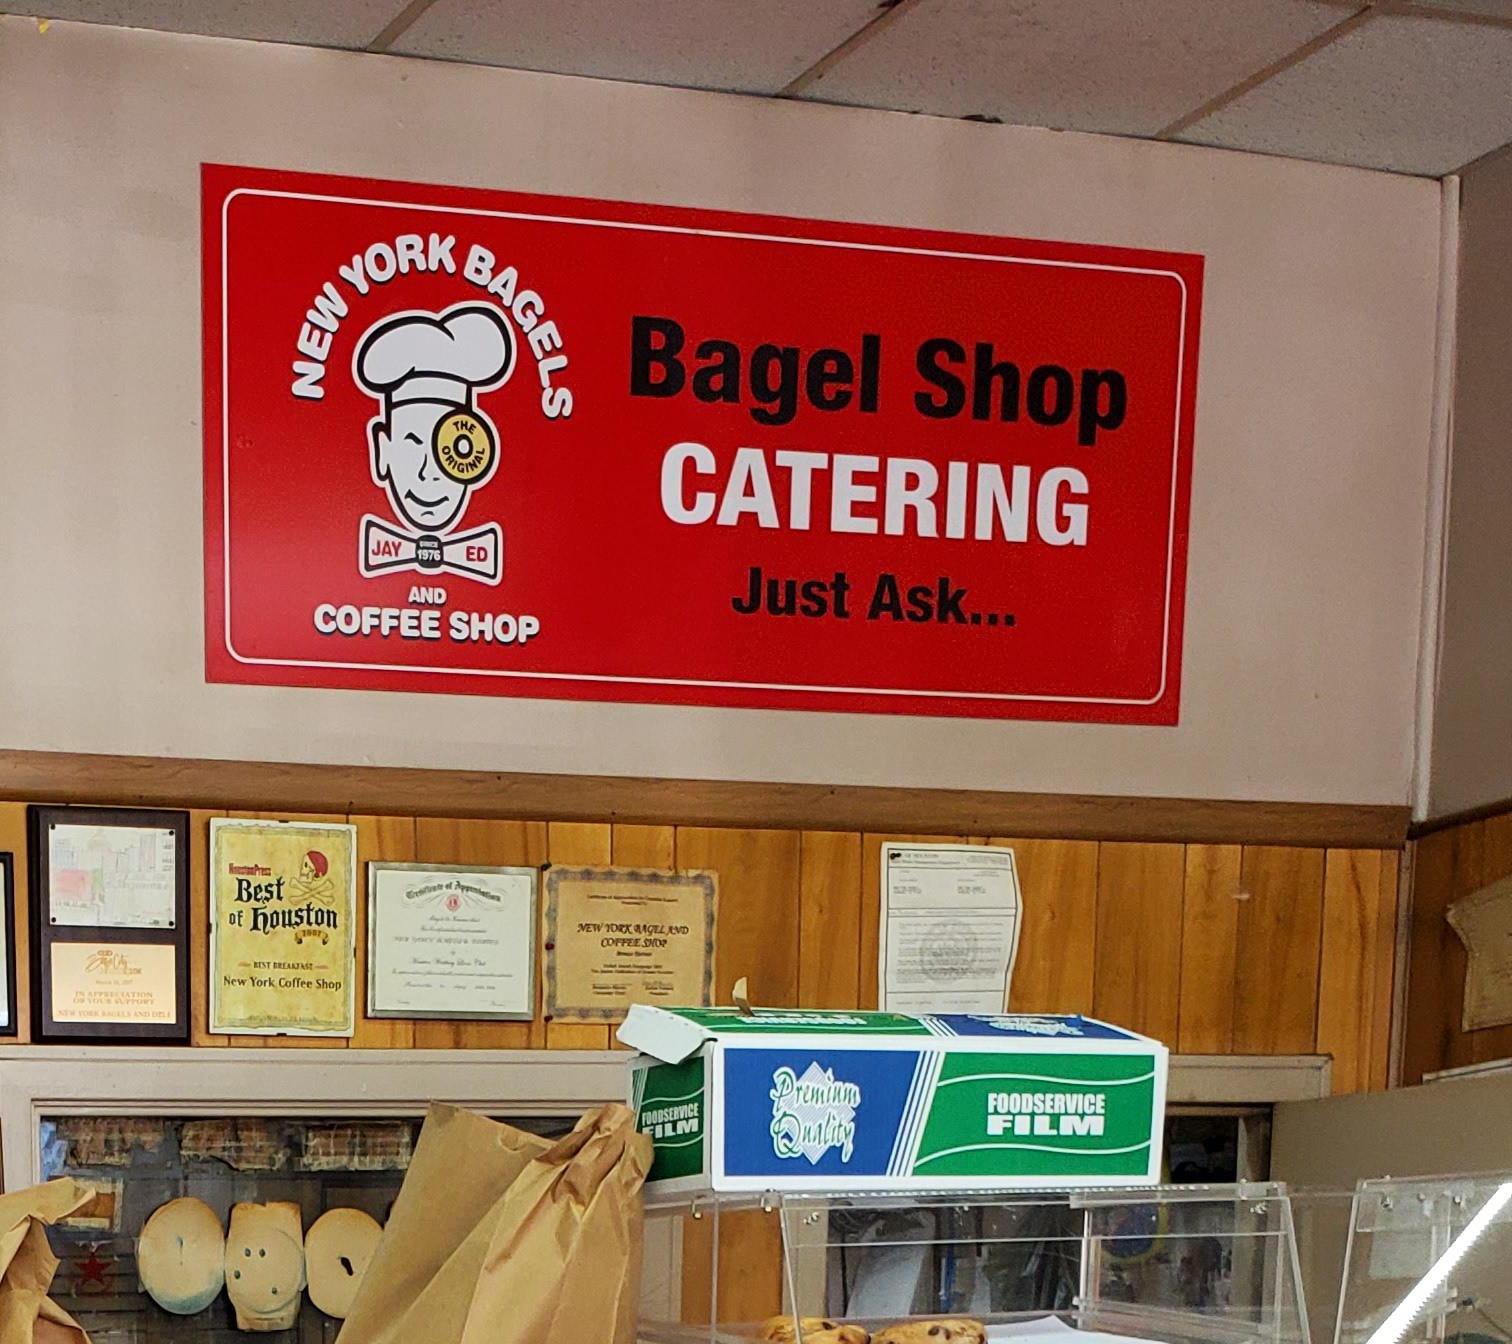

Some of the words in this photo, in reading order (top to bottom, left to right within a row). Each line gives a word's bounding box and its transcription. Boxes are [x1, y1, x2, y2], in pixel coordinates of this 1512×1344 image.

[292, 282, 349, 399] NEW
[339, 233, 456, 294] YORK
[463, 244, 573, 418] BAGELS
[629, 315, 880, 427] Bagel
[914, 338, 1127, 446] Shop
[453, 421, 477, 434] THE
[441, 446, 485, 474] ORIGINAL
[661, 441, 1089, 547] CATERING
[372, 540, 402, 557] JAY
[466, 546, 488, 562] ED
[417, 550, 441, 561] 1976
[408, 586, 447, 605] AND
[731, 566, 850, 619] Just
[867, 573, 1015, 627] Ask...
[314, 604, 441, 639] COFFEE
[449, 611, 540, 644] SHOP
[235, 876, 286, 903] Best
[229, 910, 244, 927] of
[250, 903, 338, 935] Houston
[577, 923, 603, 933] NEW
[606, 923, 632, 934] YORK
[634, 924, 666, 936] BAGEL
[666, 925, 689, 936] AND
[601, 939, 641, 947] COFFEE
[642, 939, 668, 948] SHOP
[253, 961, 271, 970] BEST
[273, 961, 313, 970] BREAKFAST
[224, 976, 247, 987] New
[249, 976, 275, 988] York
[278, 977, 312, 989] Coffee
[316, 979, 341, 992] Shop
[770, 1066, 861, 1115] Premium
[642, 1103, 699, 1126] FOODSERVICE
[987, 1093, 1105, 1115] FOODSERVICE
[642, 1118, 699, 1138] FILM
[987, 1115, 1105, 1136] FILM
[770, 1110, 854, 1164] Quality
